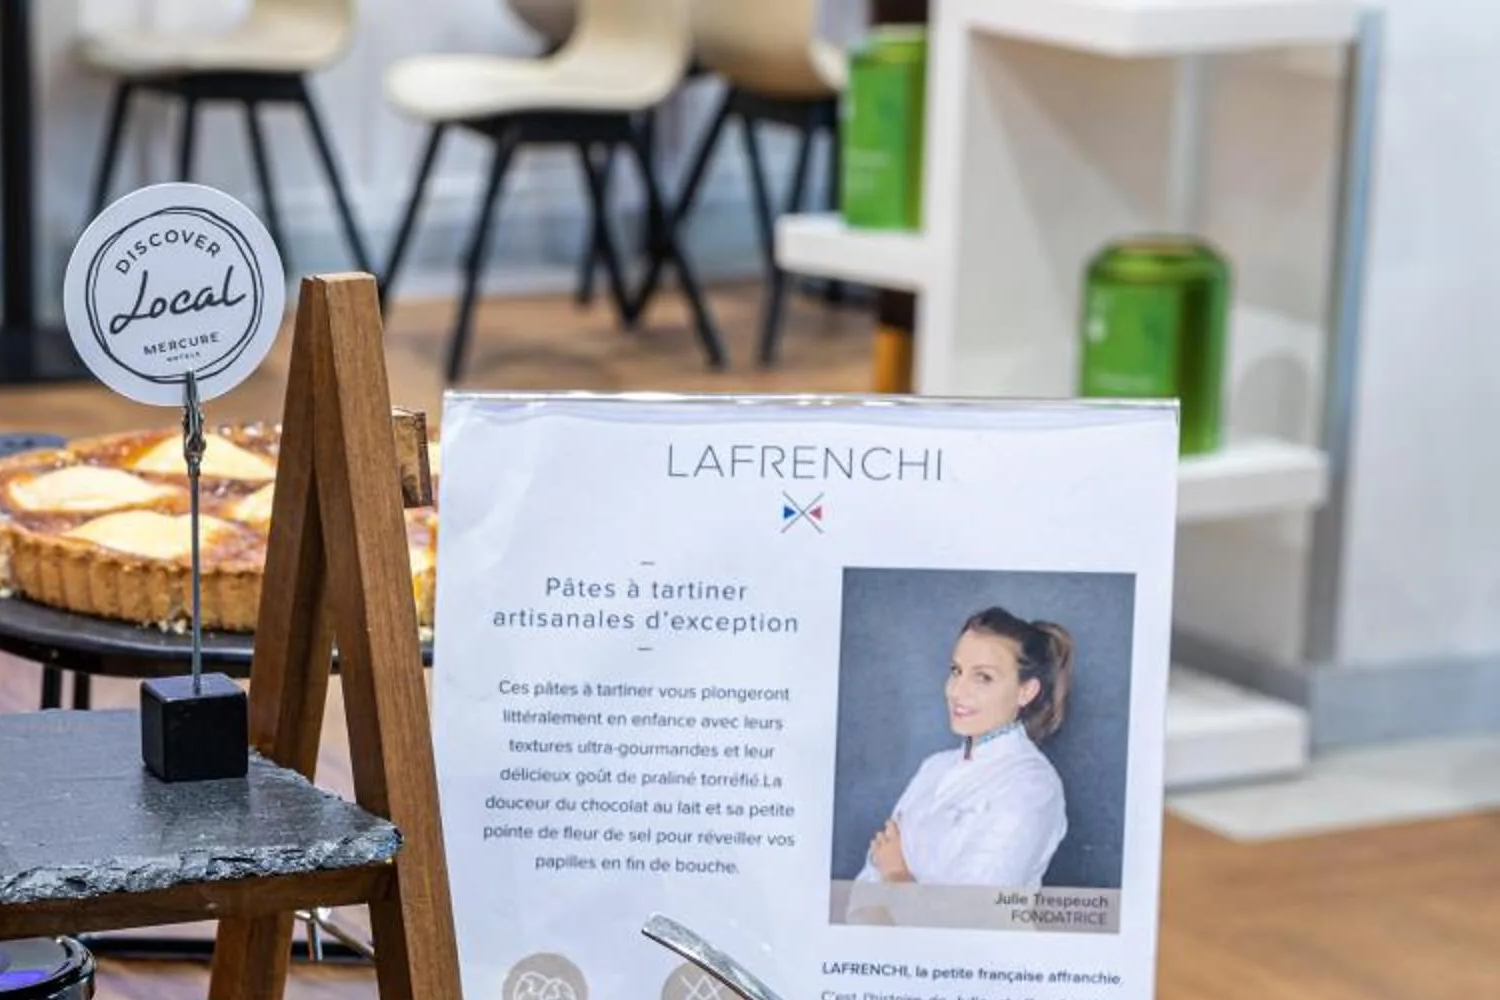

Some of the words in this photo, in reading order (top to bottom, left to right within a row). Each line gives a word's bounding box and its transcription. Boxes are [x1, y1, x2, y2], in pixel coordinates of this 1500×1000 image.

[116, 229, 220, 275] DISCOVER
[109, 265, 246, 335] Local
[144, 331, 219, 355] MERCURE
[667, 444, 942, 481] LAFRENCHI
[546, 577, 615, 599] Pâtes
[627, 577, 640, 598] à
[652, 580, 747, 601] tartiner
[493, 608, 634, 630] artisanales
[646, 610, 799, 635] d'exception
[499, 680, 529, 695] Ces
[534, 682, 578, 697] pâtes
[583, 683, 592, 697] à
[597, 684, 653, 697] tartiner
[659, 688, 696, 699] vous
[701, 686, 789, 702] plongeront
[502, 710, 602, 726] littéralement
[608, 714, 626, 726] en
[631, 713, 696, 727] enfance
[701, 717, 738, 728] avec
[744, 714, 783, 730] leurs
[509, 739, 573, 753] textures
[578, 740, 718, 758] ultra-gourmandes
[724, 744, 740, 757] et
[744, 744, 774, 758] leur
[500, 767, 570, 782] délicieux
[576, 769, 611, 786] goût
[617, 770, 637, 784] de
[641, 771, 696, 787] praliné
[485, 795, 550, 809] douceur
[556, 798, 576, 811] du
[581, 799, 648, 813] chocolat
[653, 803, 672, 814] au
[678, 801, 700, 815] lait
[706, 803, 721, 815] et
[726, 806, 744, 816] sa
[749, 803, 795, 819] petite
[483, 824, 532, 841] pointe
[538, 825, 558, 838] de
[563, 826, 598, 840] fleur
[603, 828, 624, 842] de
[629, 829, 651, 842] sel
[656, 831, 693, 845] pour
[698, 831, 762, 845] réveiller
[767, 834, 795, 846] vos
[536, 855, 595, 871] papilles
[601, 859, 621, 870] en
[625, 857, 645, 871] fin
[650, 858, 670, 872] de
[676, 859, 739, 874] bouche.
[996, 892, 1028, 906] Julie
[1034, 893, 1109, 909] Trespeuch
[1012, 909, 1108, 925] FONDATRICE
[915, 966, 928, 978] la
[932, 966, 973, 981] petite
[978, 967, 1044, 983] française
